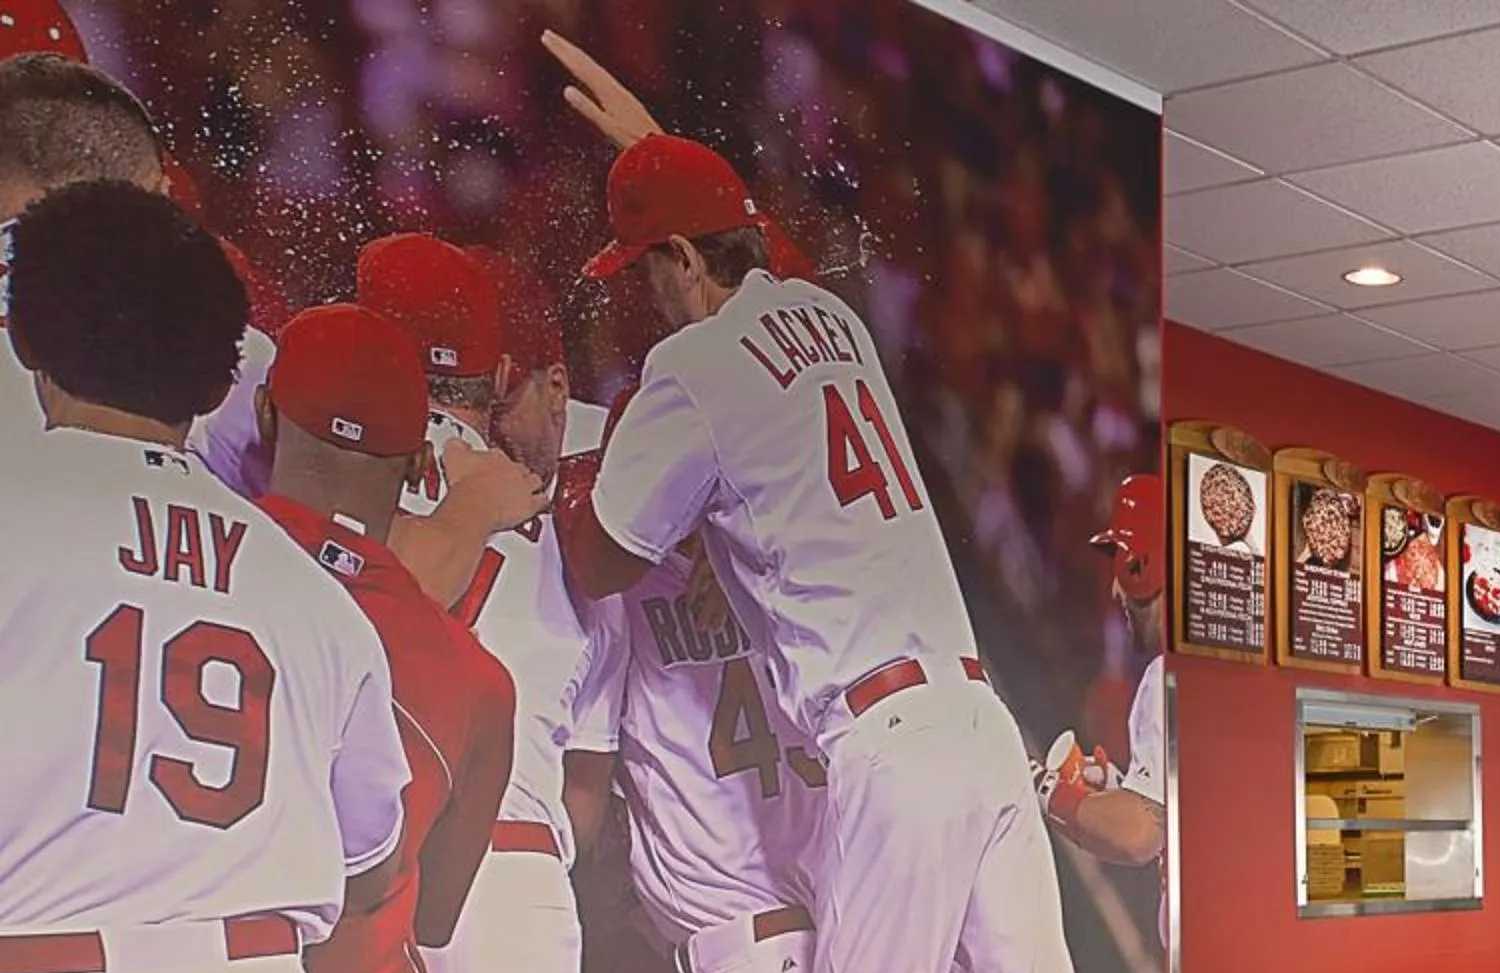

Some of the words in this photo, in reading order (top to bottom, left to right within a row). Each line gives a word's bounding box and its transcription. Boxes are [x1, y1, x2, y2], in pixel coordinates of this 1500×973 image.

[739, 305, 864, 391] LACKEY
[822, 378, 924, 521] 41
[118, 495, 249, 594] JAY
[85, 602, 277, 831] 19
[708, 655, 830, 798] 4
